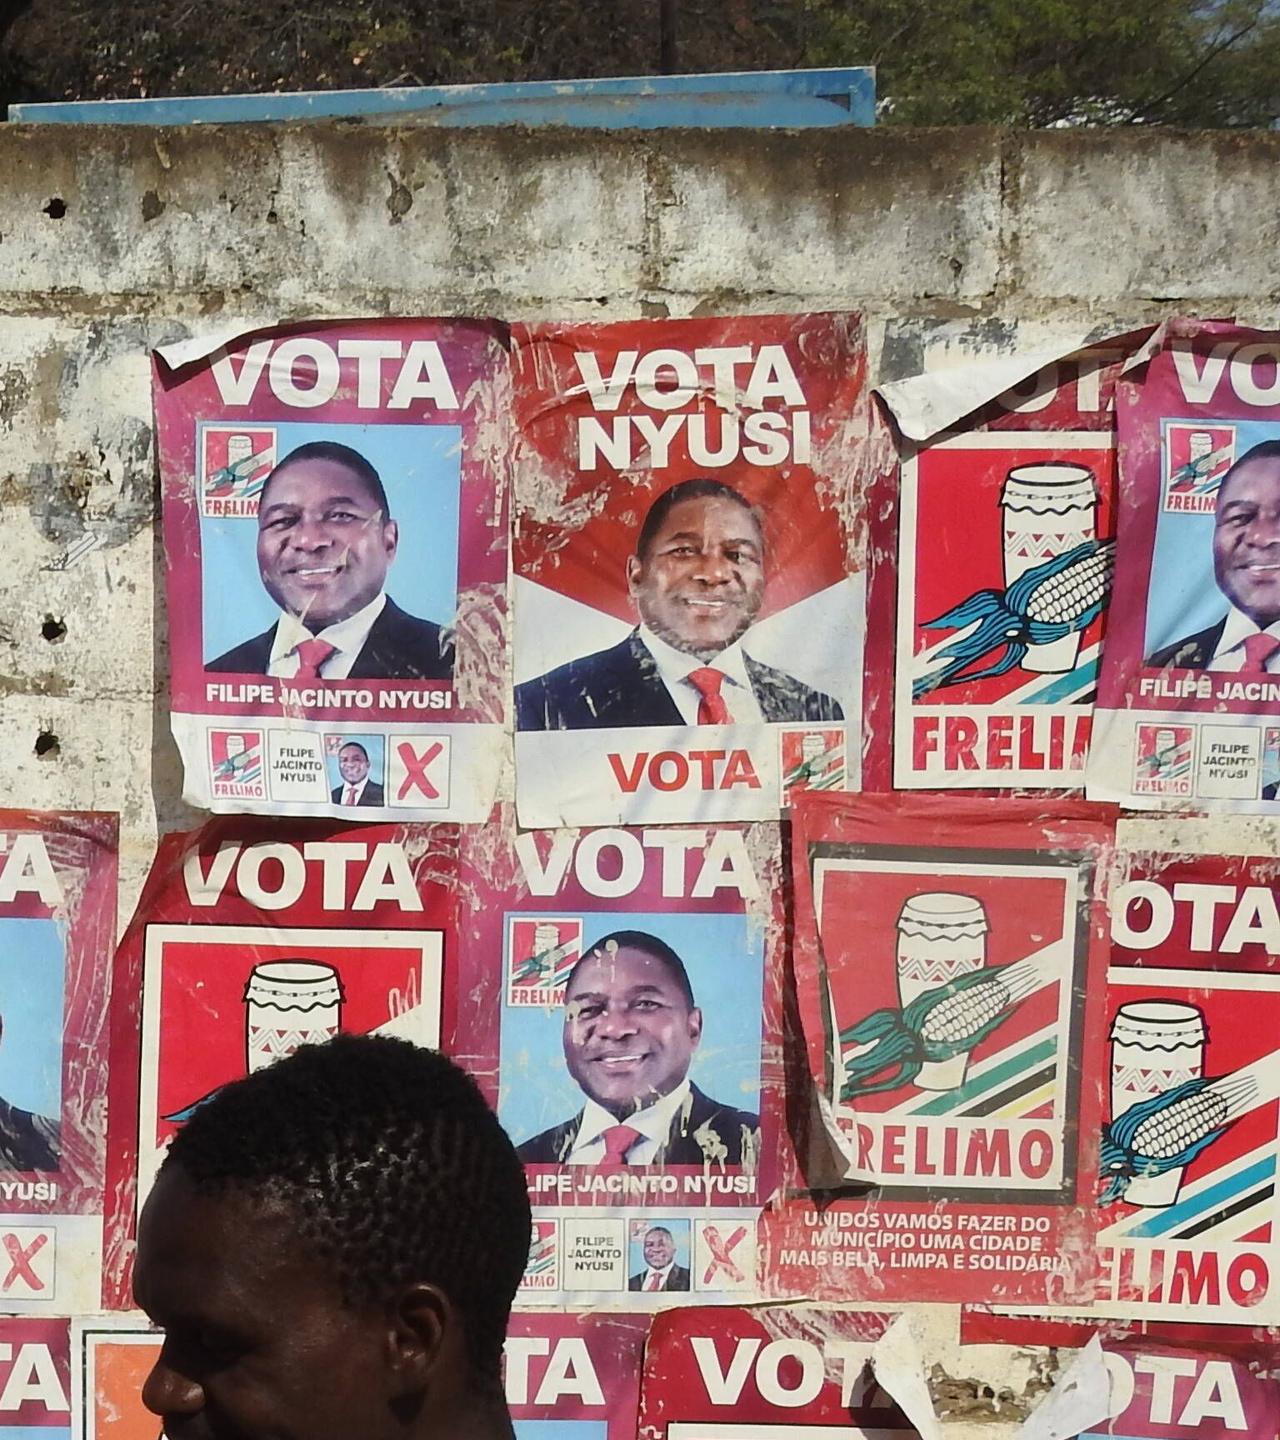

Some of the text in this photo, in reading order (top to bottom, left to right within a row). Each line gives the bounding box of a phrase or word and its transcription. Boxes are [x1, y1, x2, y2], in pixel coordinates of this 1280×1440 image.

[205, 339, 461, 410] VOTA
[572, 345, 807, 413] VOTA
[579, 412, 811, 471] NYUSI
[206, 684, 452, 710] FILIPE JACINTO NYUSI
[1140, 679, 1212, 699] FILIPE
[279, 748, 315, 760] FILIPE
[273, 760, 323, 772] JACINTO
[608, 750, 761, 794] VOTA
[279, 771, 317, 784] NYUSI
[1135, 779, 1189, 793] FRELIMO
[214, 784, 263, 798] FRELIMO
[514, 828, 760, 901] VOTA
[182, 841, 424, 912] VOTA
[578, 1174, 757, 1195] JACINTO NYUSI
[804, 1211, 1051, 1233] UNIDOS VAMOS FAZER DO
[575, 1235, 614, 1247] FILIPE
[810, 1228, 1042, 1251] MUNICÍPIO UMA CIDADE
[567, 1248, 622, 1260] JACINTO
[779, 1250, 827, 1267] MAIS
[832, 1251, 886, 1271] BELA,
[890, 1253, 949, 1269] LIMPA
[953, 1253, 965, 1270] E
[575, 1261, 614, 1272] NYUSI
